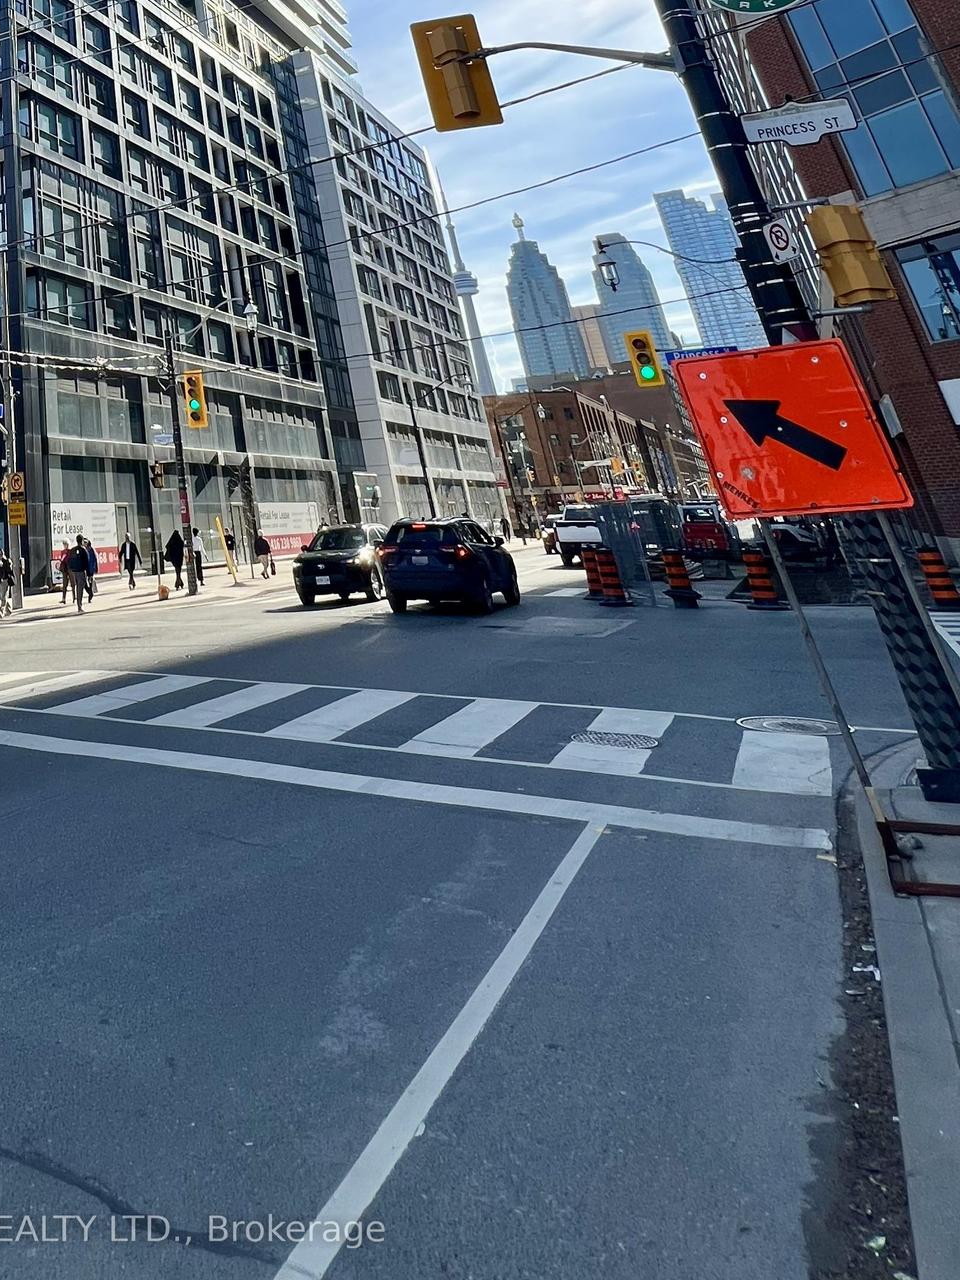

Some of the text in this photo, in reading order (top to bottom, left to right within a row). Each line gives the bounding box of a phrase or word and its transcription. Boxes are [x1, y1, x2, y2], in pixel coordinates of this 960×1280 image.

[757, 117, 841, 139] PRINCESS ST
[53, 509, 72, 521] Retail
[53, 523, 84, 534] For Lease
